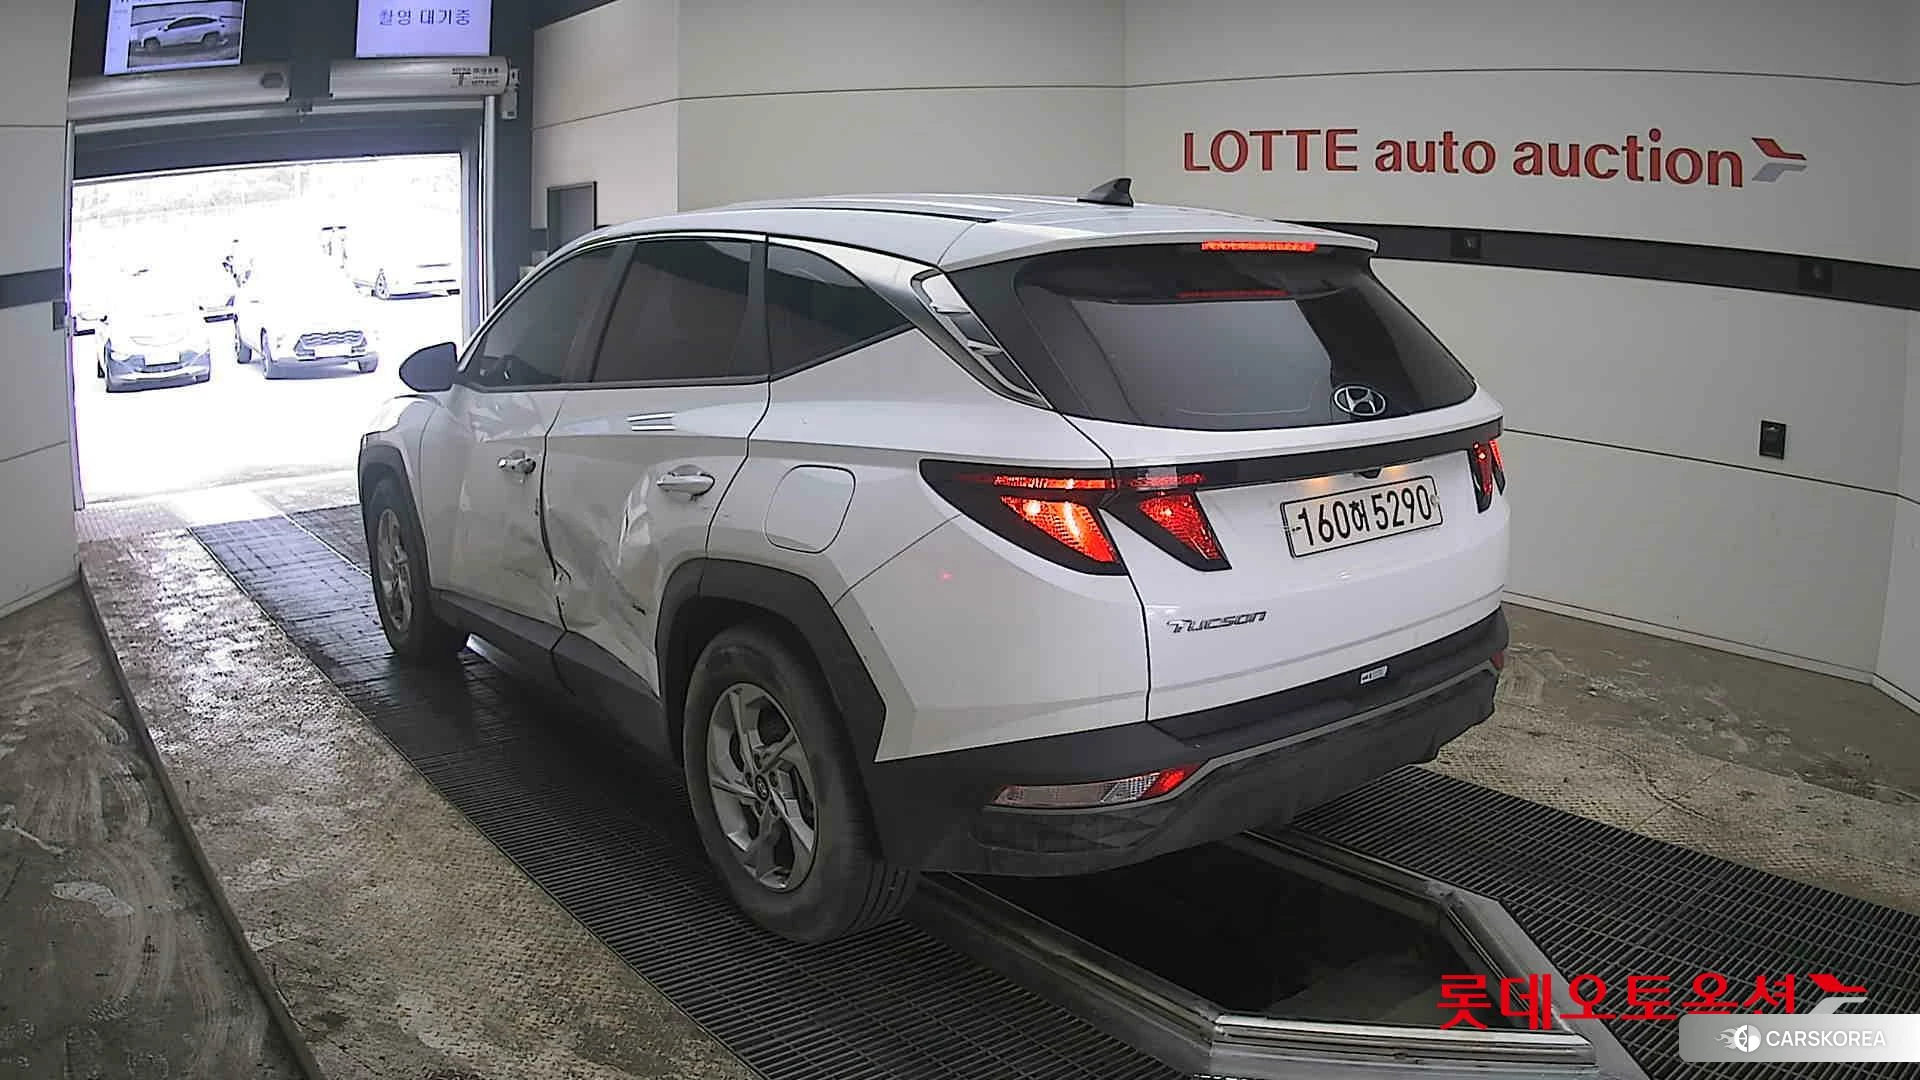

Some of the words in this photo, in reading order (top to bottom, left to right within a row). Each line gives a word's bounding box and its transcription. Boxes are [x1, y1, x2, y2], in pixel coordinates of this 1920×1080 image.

[420, 8, 470, 26] 대기중
[1183, 128, 1359, 173] LOTTE
[1374, 130, 1497, 174] auto
[1513, 127, 1743, 188] auction
[1371, 484, 1432, 530] 5290
